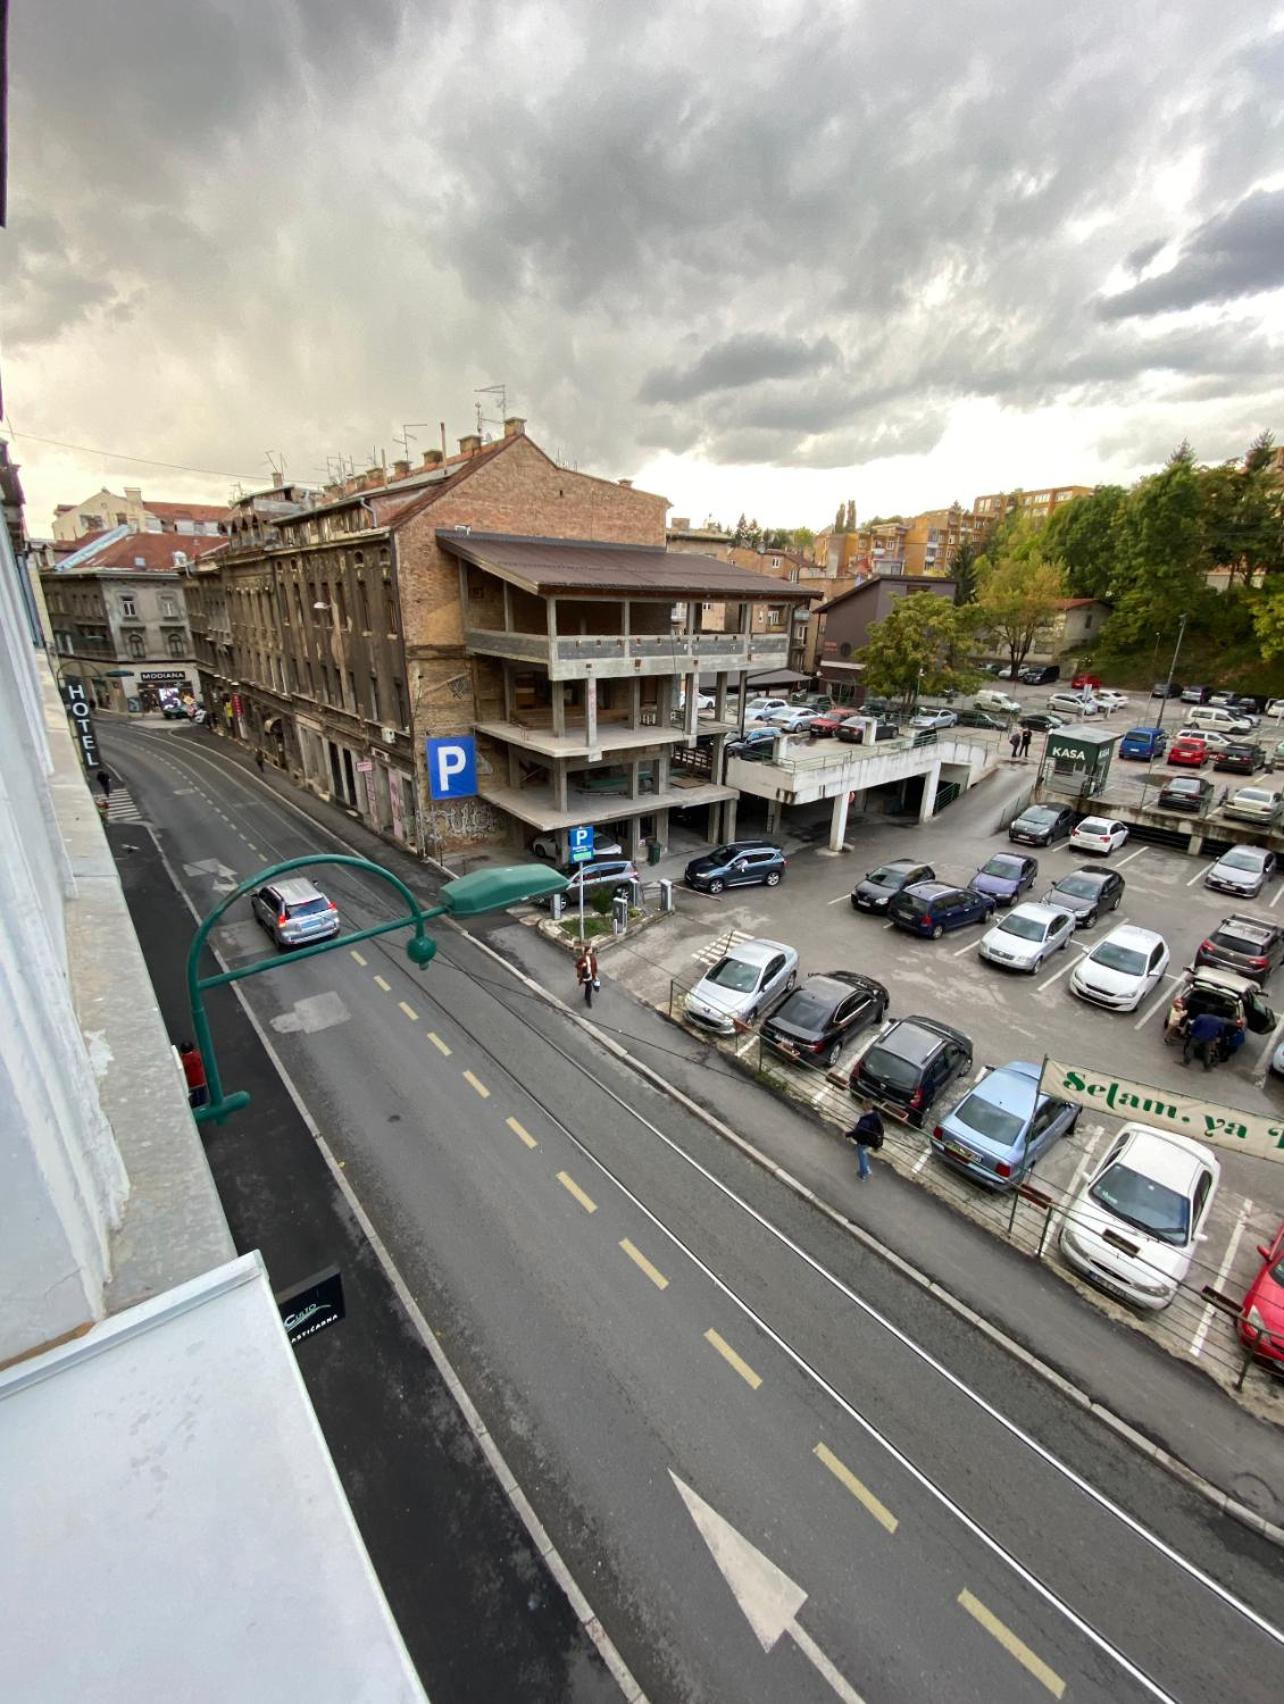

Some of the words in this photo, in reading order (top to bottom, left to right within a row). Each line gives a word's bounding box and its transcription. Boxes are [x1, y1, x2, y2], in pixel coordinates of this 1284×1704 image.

[142, 672, 185, 680] MODIANA
[68, 684, 100, 766] HOTEL
[1052, 747, 1085, 760] KASA
[437, 745, 467, 792] P
[576, 829, 588, 846] P
[1204, 1114, 1248, 1139] ya
